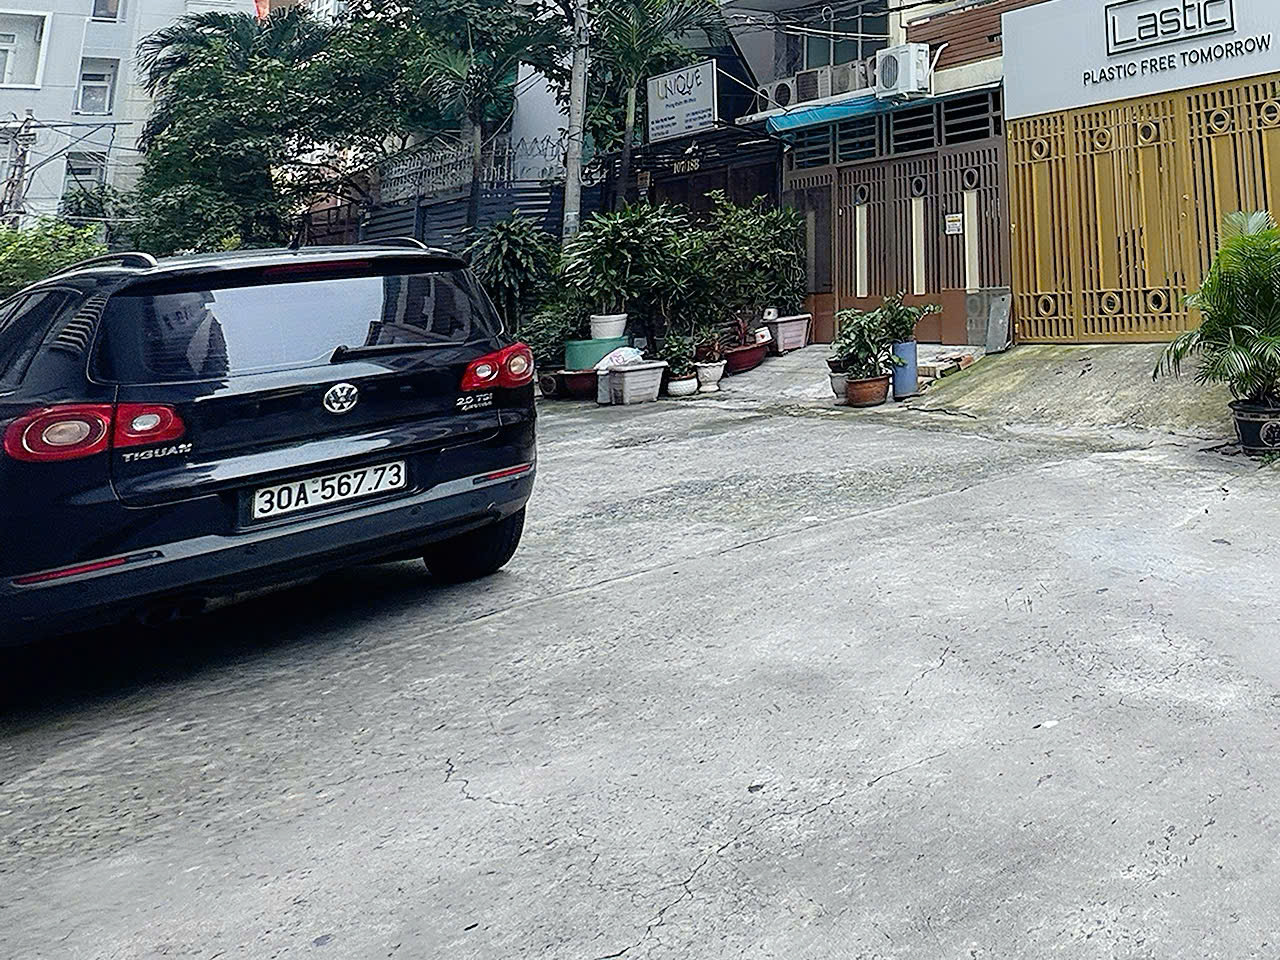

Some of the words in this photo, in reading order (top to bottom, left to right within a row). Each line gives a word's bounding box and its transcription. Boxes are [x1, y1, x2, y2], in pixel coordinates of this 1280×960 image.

[1083, 62, 1138, 86] PLASTIC
[1140, 53, 1177, 76] FREE
[1179, 34, 1272, 68] TOMORROW
[122, 442, 193, 463] TIGUAN
[258, 463, 402, 514] 30A-567.73
